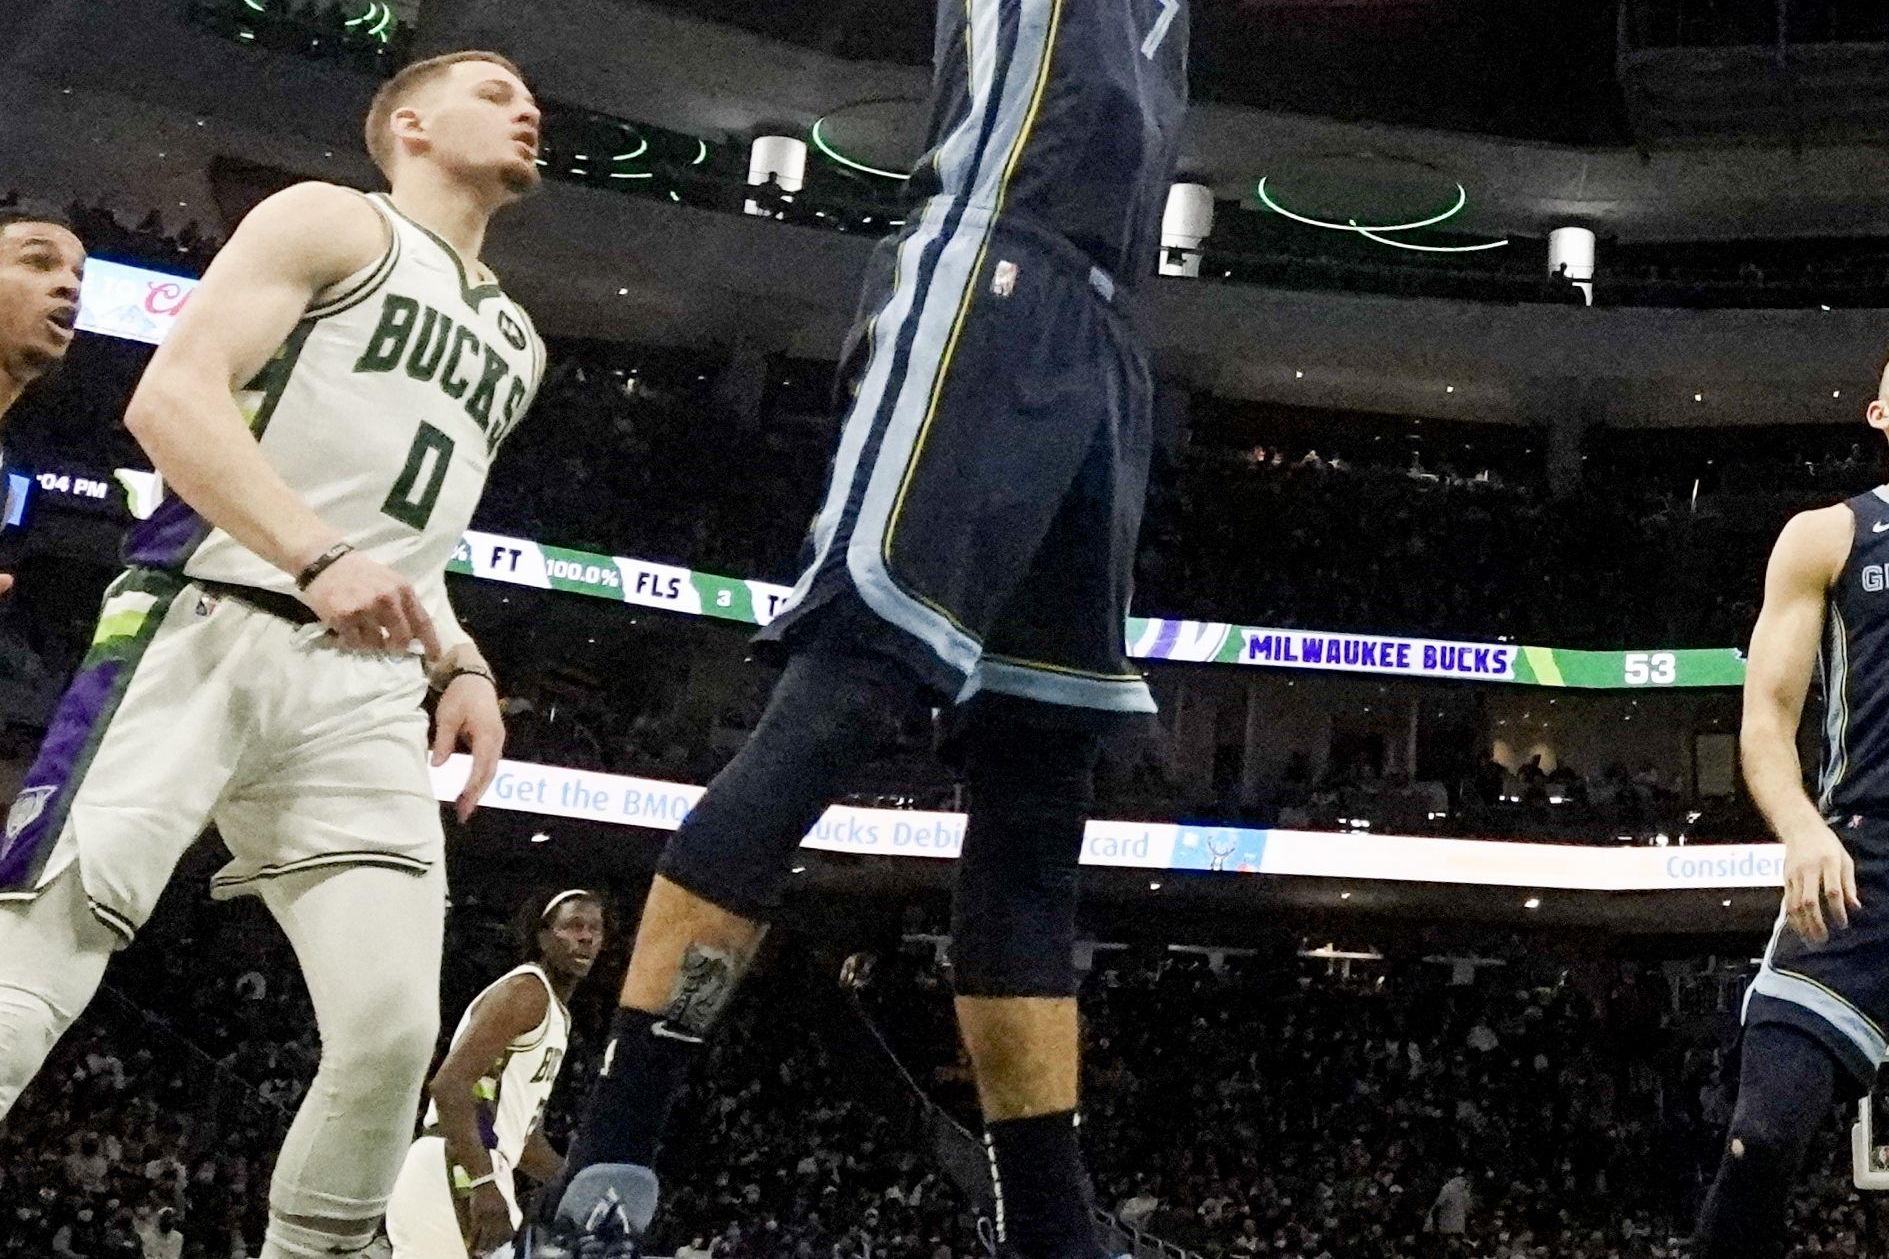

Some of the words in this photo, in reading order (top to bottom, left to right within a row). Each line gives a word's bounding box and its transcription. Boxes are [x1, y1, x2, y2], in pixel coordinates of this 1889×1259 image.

[353, 293, 527, 446] BUCKS
[73, 478, 108, 499] PM
[380, 420, 455, 530] 0
[490, 546, 522, 573] FT
[546, 558, 620, 588] 100.0%
[636, 571, 681, 600] FLS
[716, 590, 731, 607] 3
[1248, 634, 1411, 670] MILWAUKEE
[1422, 645, 1509, 676] BUCKS
[1623, 651, 1677, 685] 53
[495, 773, 546, 806] Get
[560, 781, 609, 812] the
[623, 788, 690, 821] BMO
[1666, 851, 1784, 879] Consider
